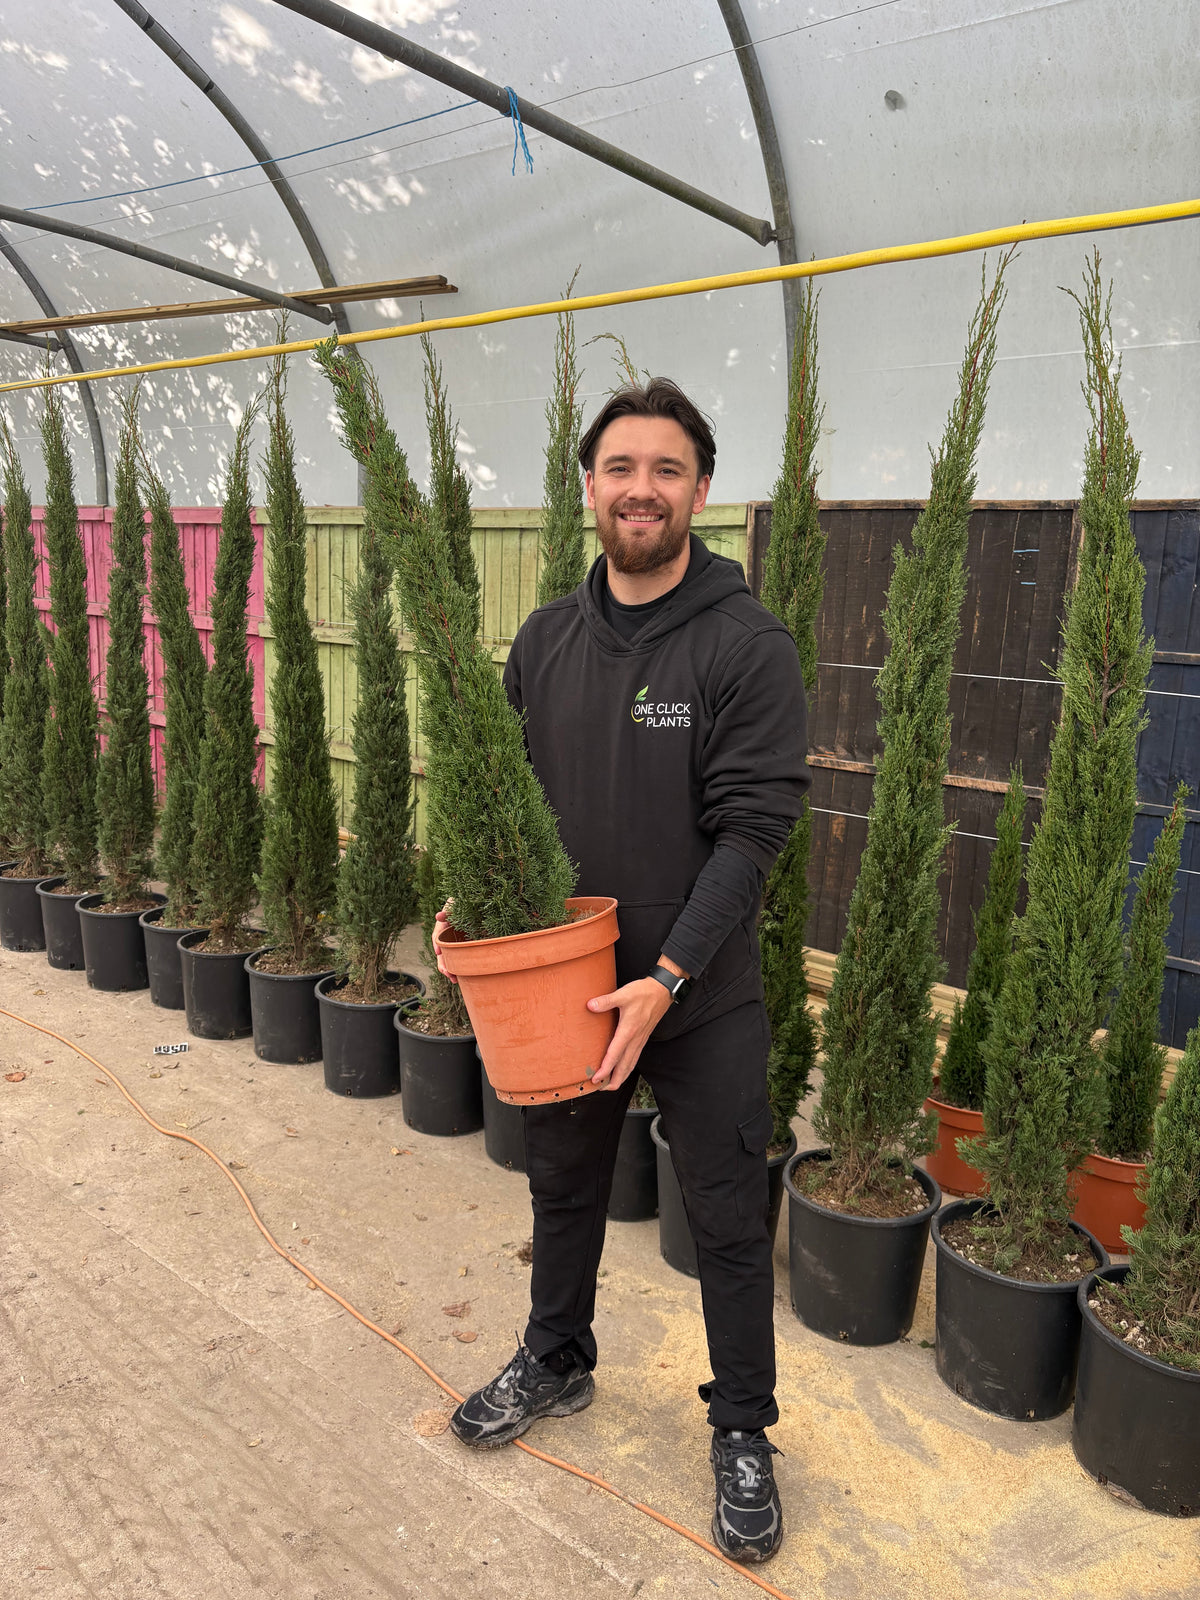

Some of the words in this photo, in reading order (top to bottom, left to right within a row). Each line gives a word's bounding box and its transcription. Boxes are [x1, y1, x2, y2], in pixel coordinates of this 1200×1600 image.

[634, 703, 654, 715] ONE
[656, 703, 691, 714] CLICK
[646, 716, 691, 728] PLANTS
